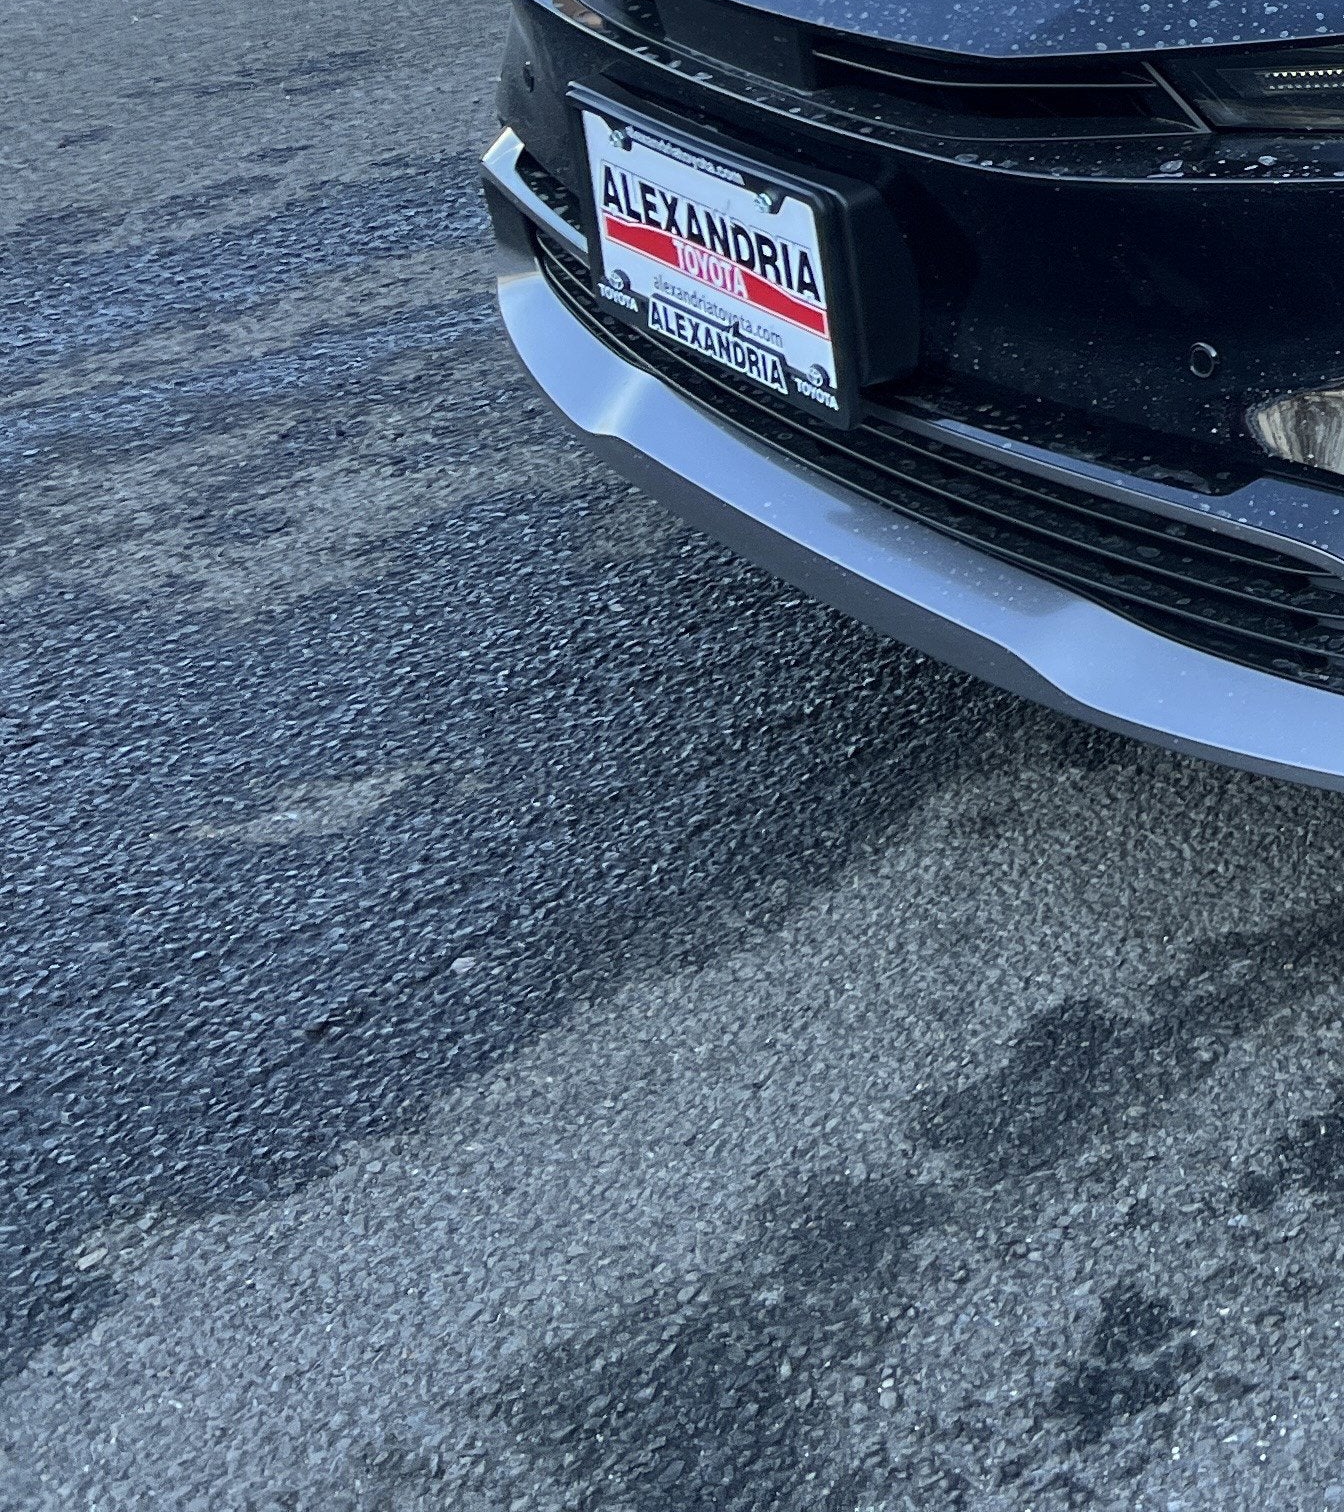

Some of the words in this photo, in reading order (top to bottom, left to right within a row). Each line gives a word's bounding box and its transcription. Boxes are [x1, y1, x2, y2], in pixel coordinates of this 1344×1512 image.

[602, 164, 821, 303] ALEXANDRIA
[597, 281, 639, 313] TOYOTA
[671, 237, 749, 299] TOYOTA
[651, 300, 784, 392] ALEXANDRIA
[793, 377, 840, 411] TOYOTA
